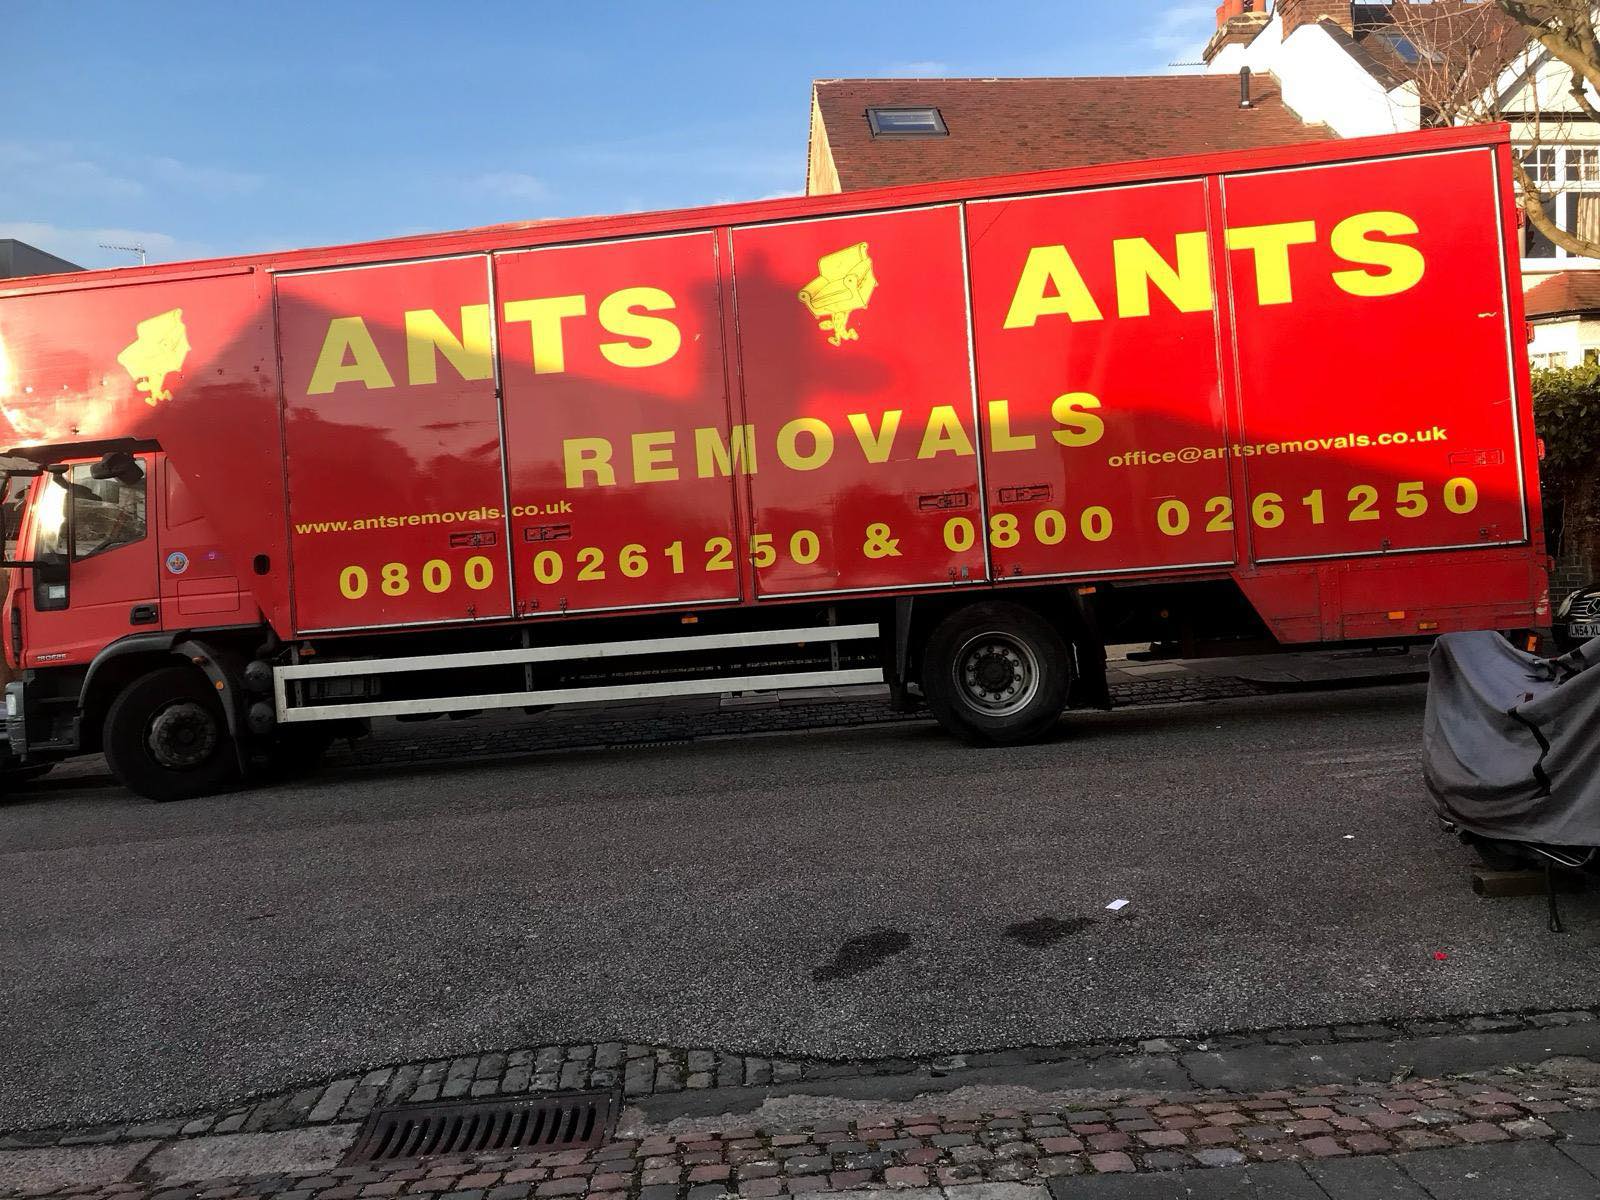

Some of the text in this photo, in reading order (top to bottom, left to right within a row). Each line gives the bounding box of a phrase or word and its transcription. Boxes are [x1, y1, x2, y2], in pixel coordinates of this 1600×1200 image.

[1003, 210, 1425, 330] ANTS
[306, 287, 682, 395] ANTS
[563, 391, 1105, 489] REMOVALS
[1107, 426, 1448, 467] office@antsremovals.co.uk
[295, 500, 573, 534] www.antsremovals.co.uk
[339, 477, 1479, 600] 0800 0261250 & 0800 0261250
